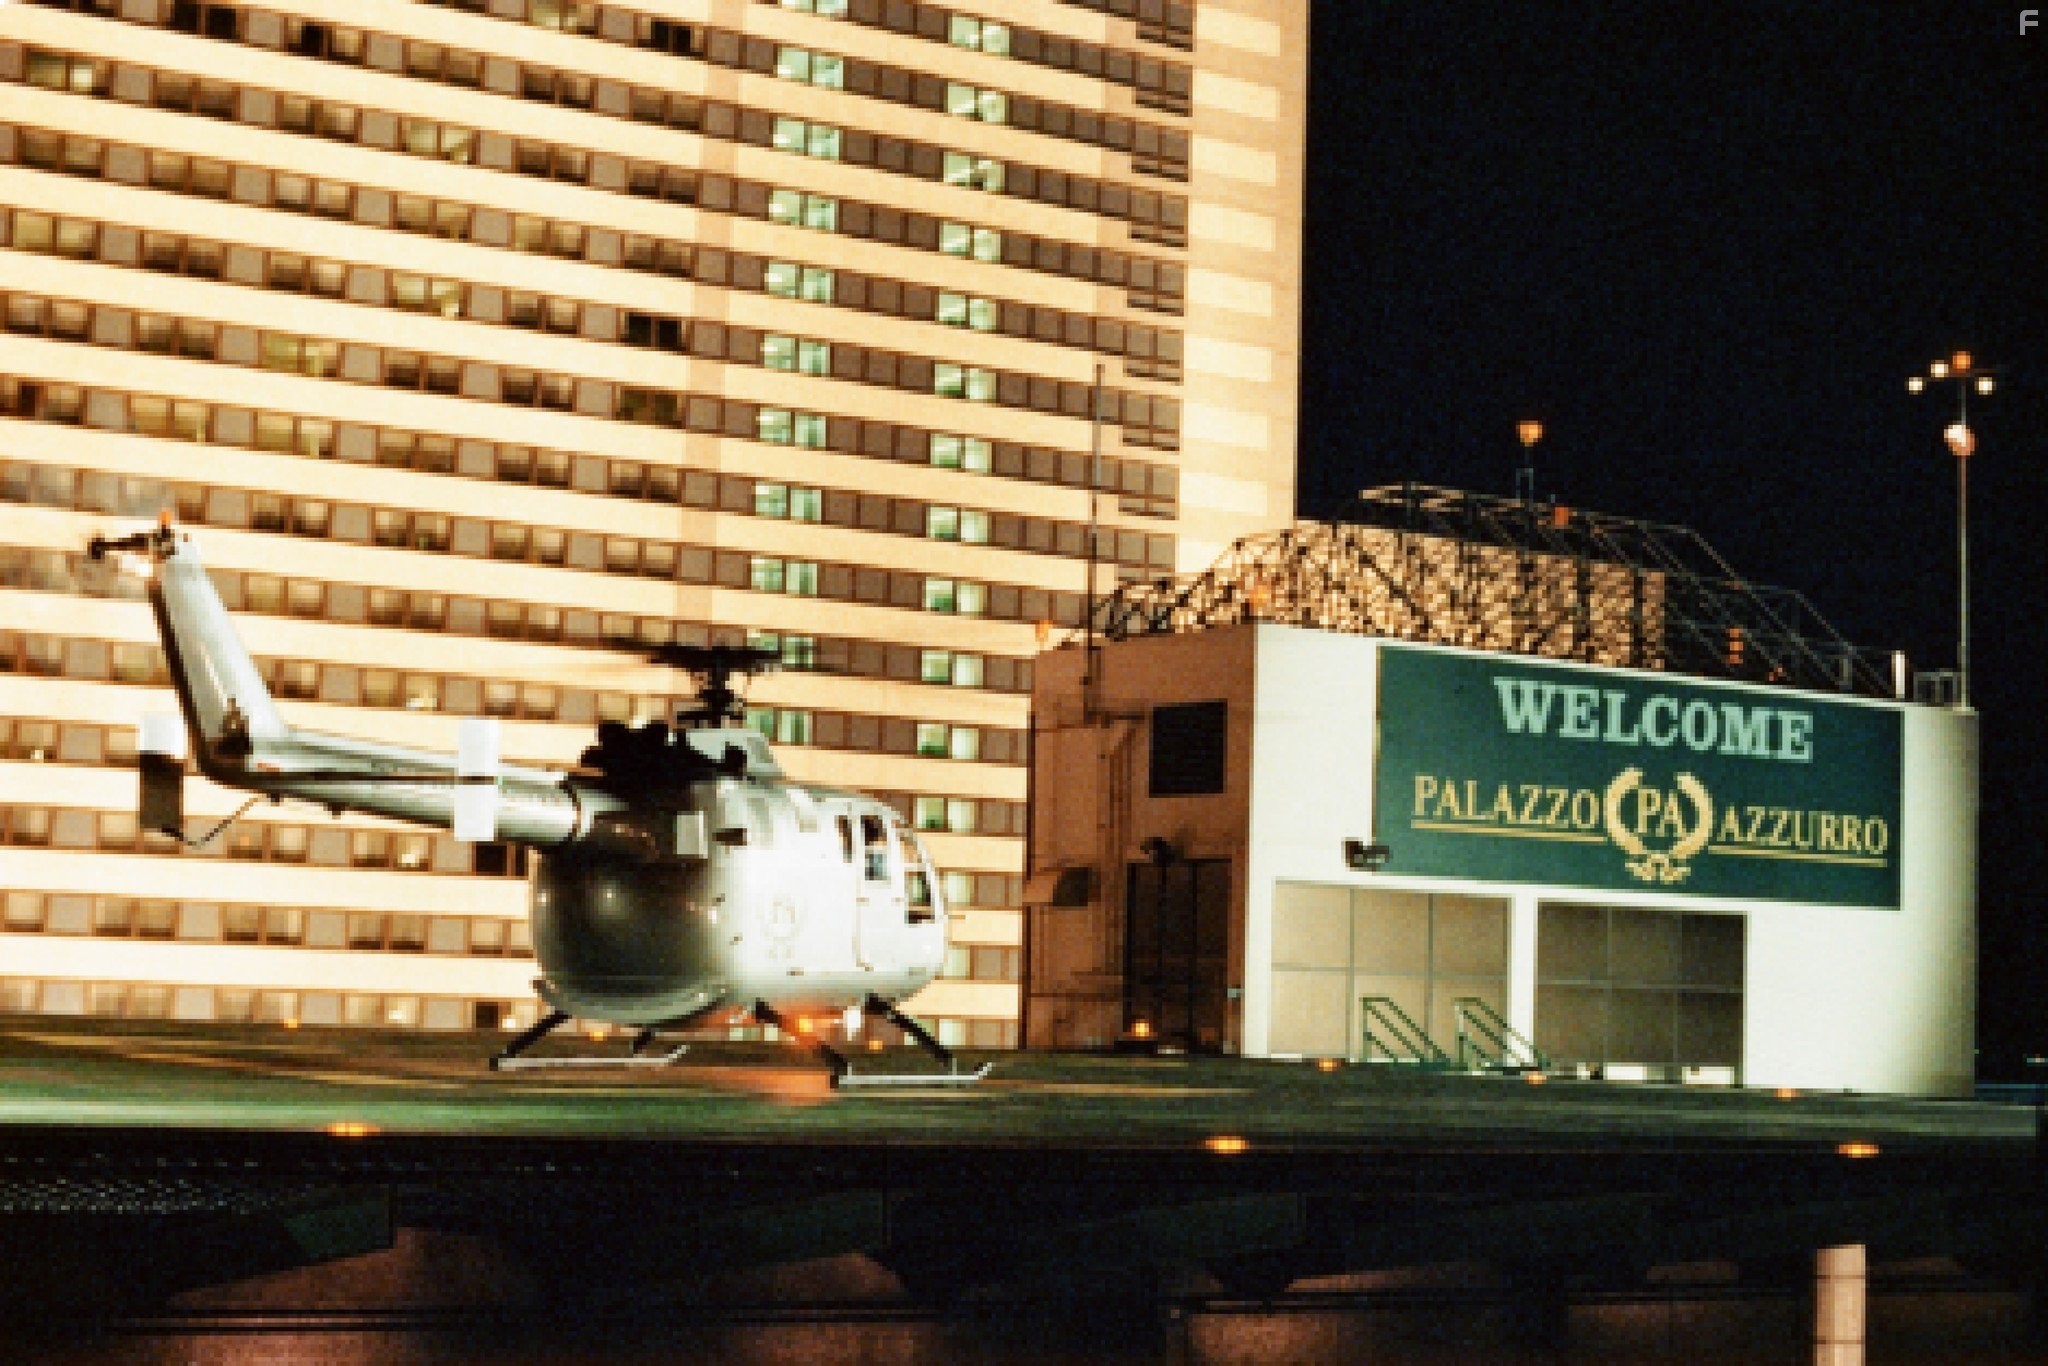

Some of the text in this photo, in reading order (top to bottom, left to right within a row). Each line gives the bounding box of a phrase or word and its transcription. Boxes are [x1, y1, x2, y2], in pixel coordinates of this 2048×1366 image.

[1493, 676, 1814, 762] WELCOME
[1413, 774, 1889, 856] PALAZZO PA AZZURRO
